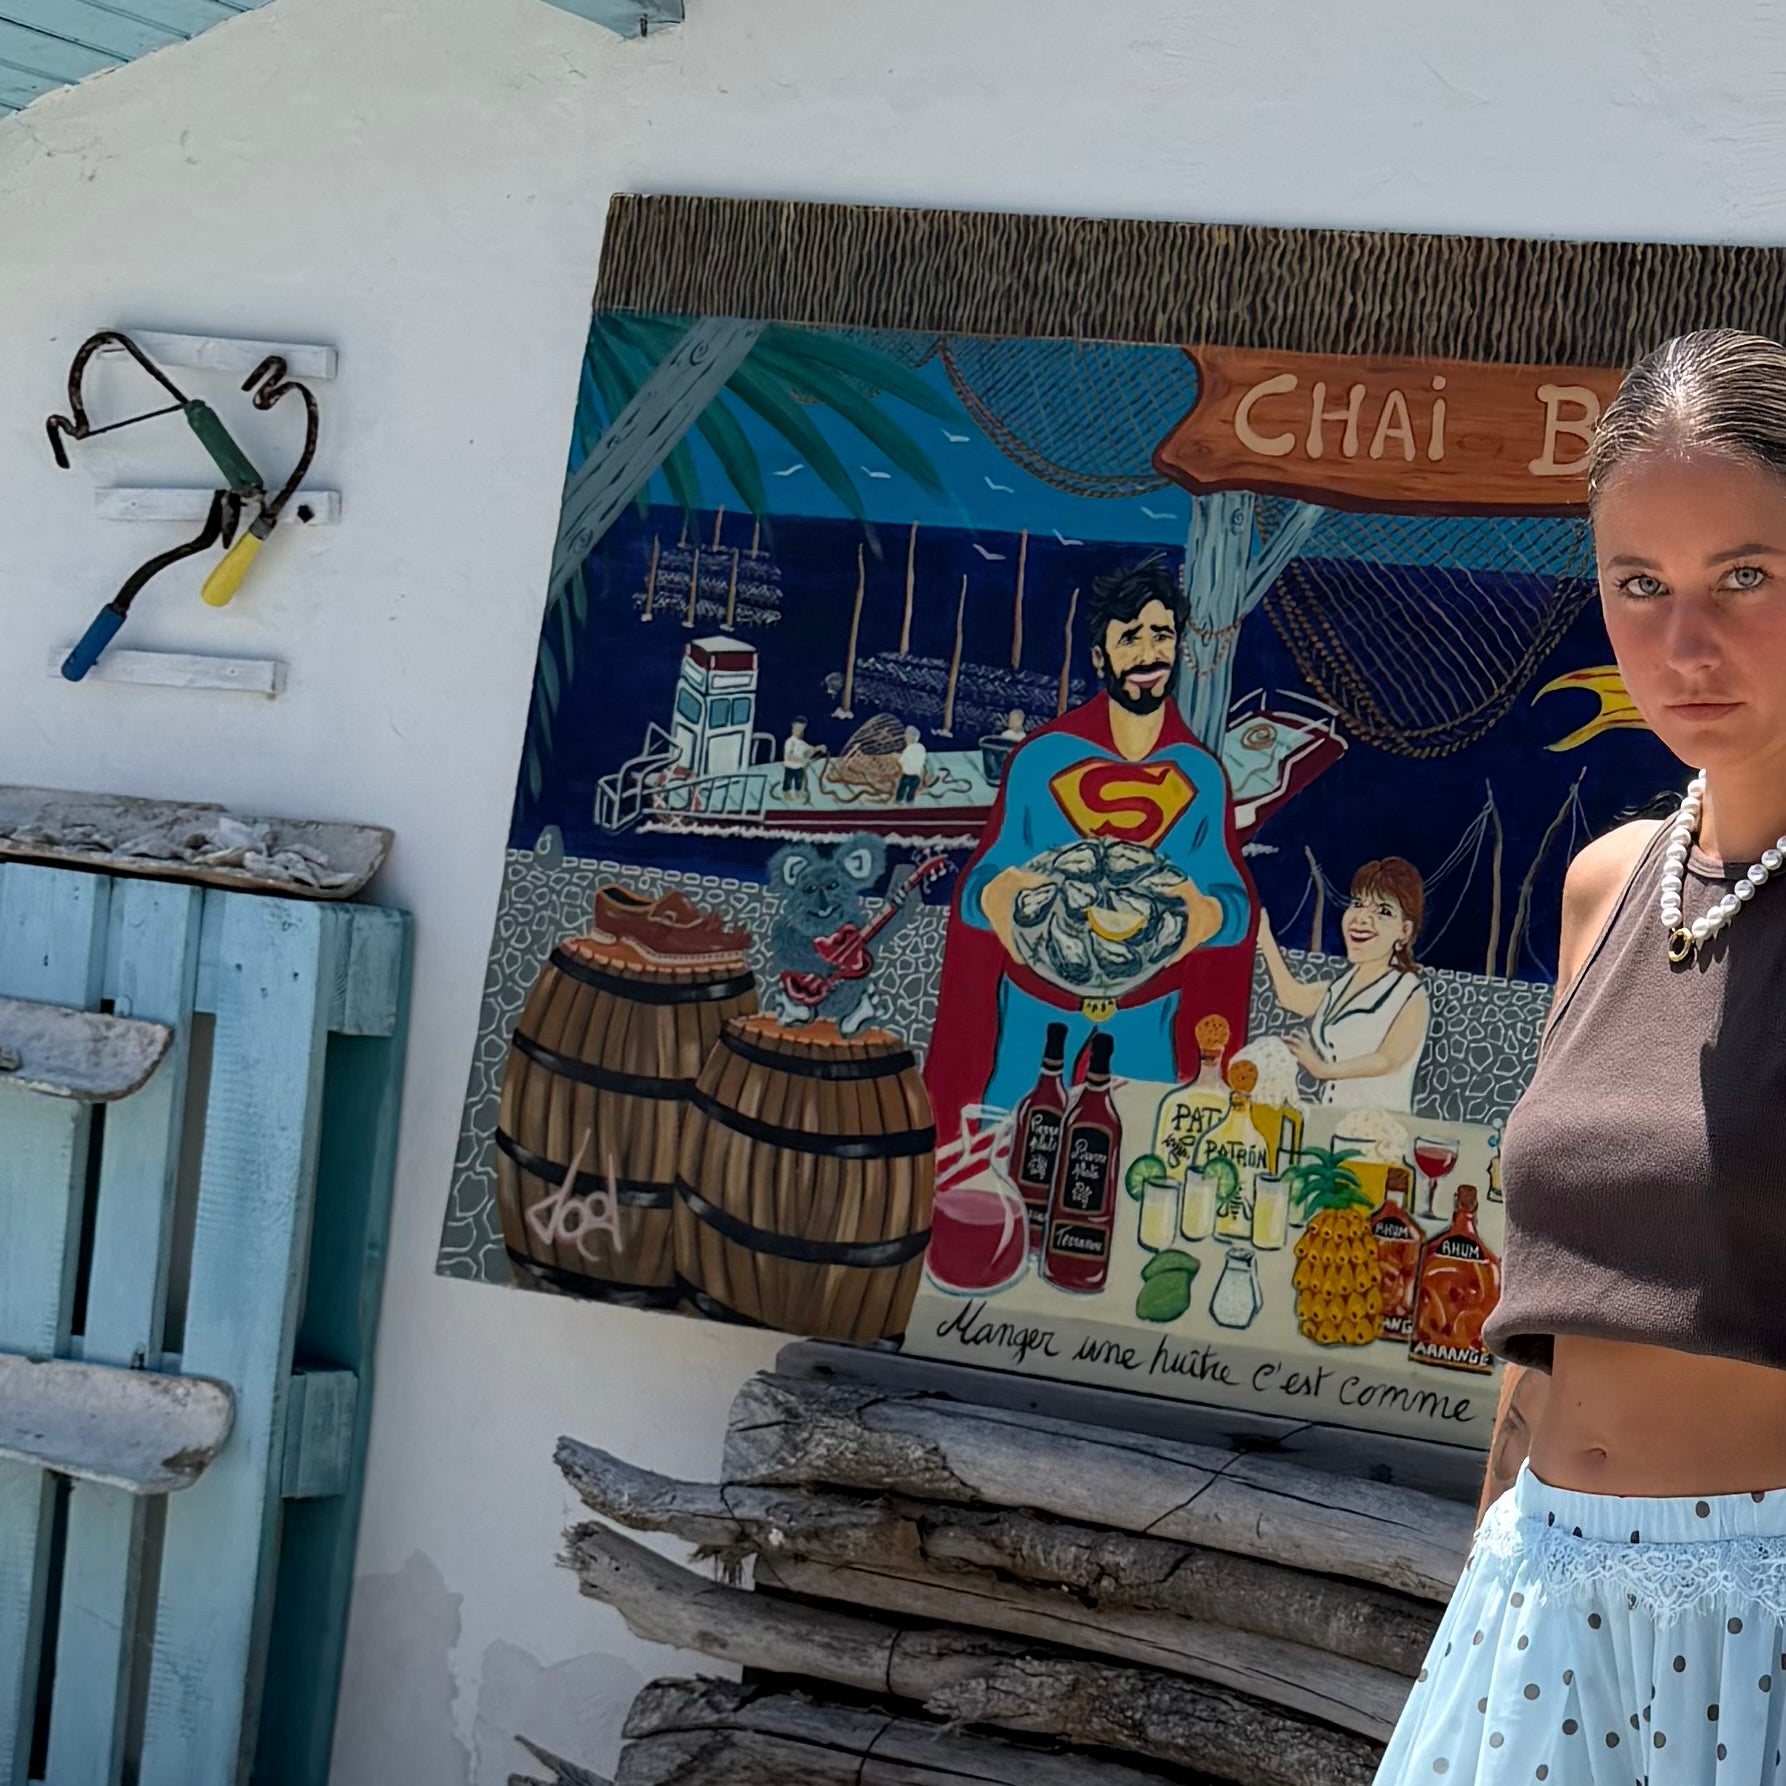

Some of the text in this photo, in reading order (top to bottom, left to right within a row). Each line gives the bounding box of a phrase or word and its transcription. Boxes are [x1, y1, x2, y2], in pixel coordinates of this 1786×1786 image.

[936, 1299, 1058, 1364] Manger
[1072, 1335, 1143, 1370] une
[1149, 1334, 1240, 1386] huître
